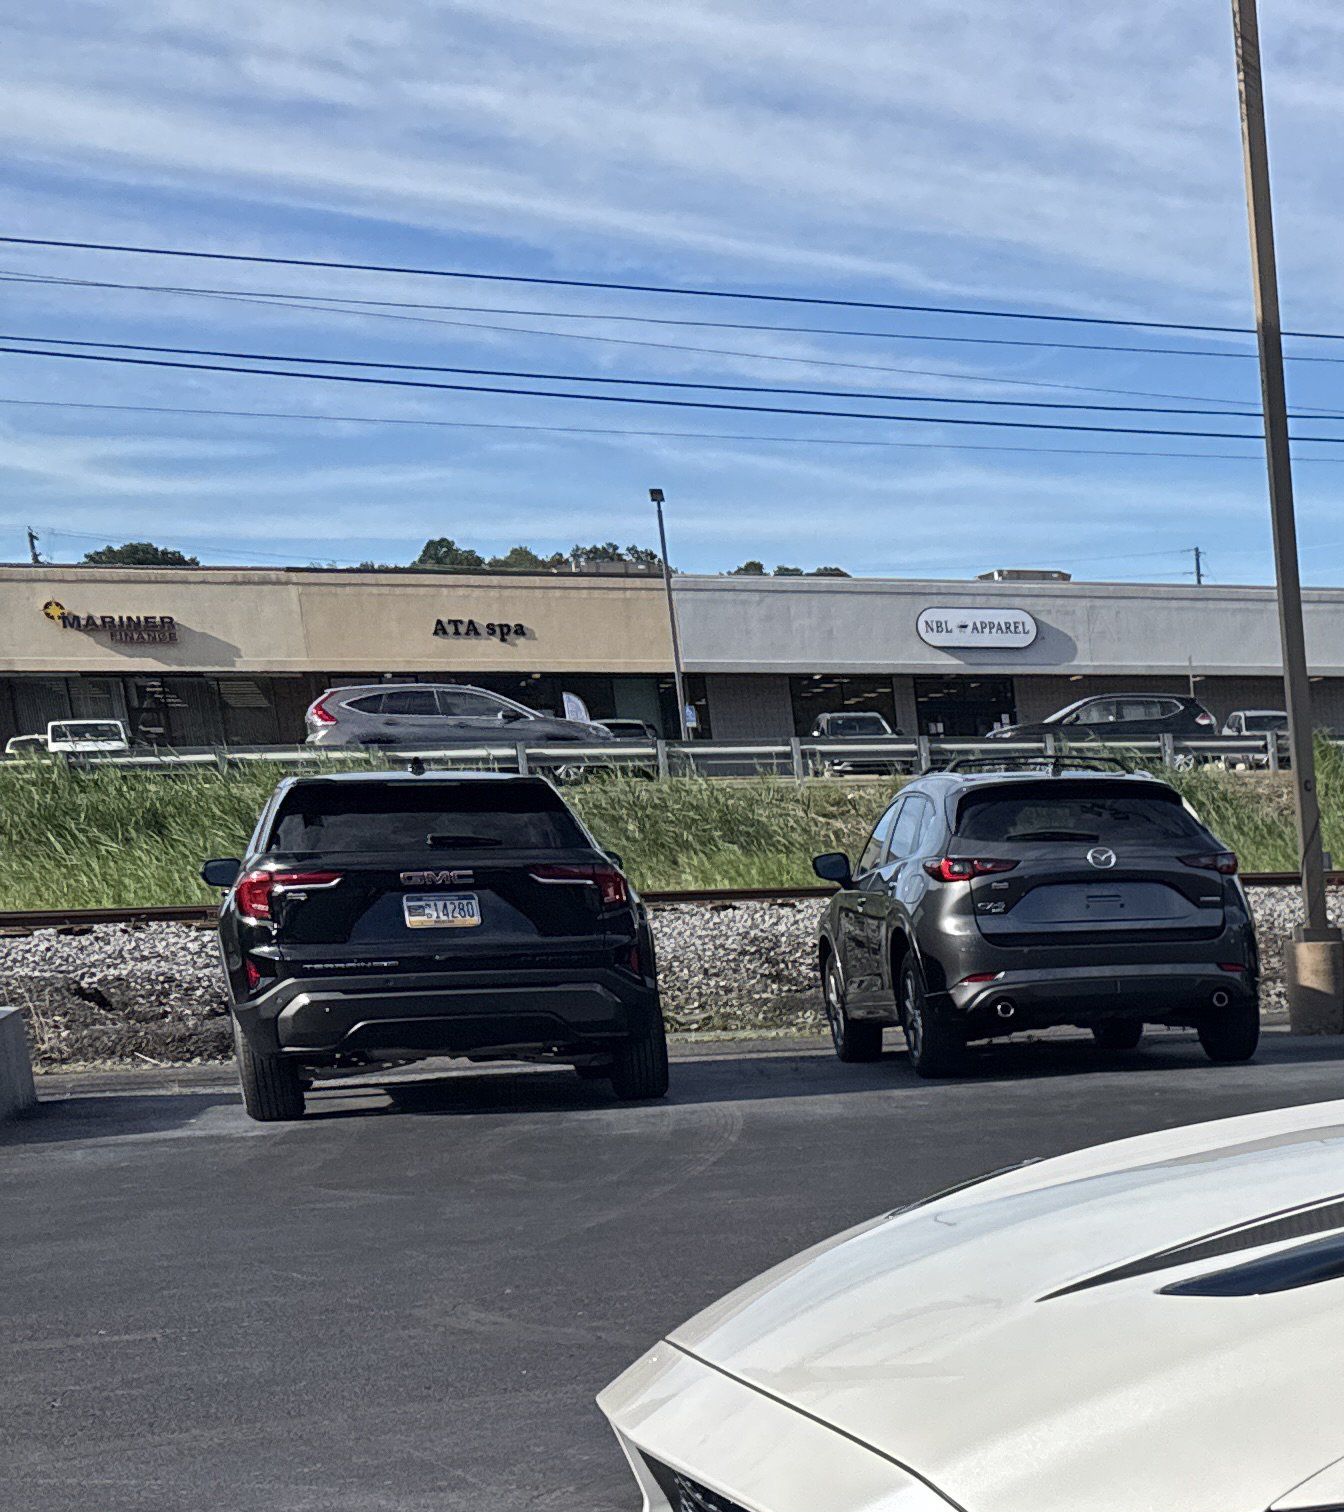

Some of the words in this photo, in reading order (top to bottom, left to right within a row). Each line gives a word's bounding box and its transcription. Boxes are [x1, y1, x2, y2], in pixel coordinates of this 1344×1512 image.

[61, 615, 177, 629] MARINER
[924, 620, 953, 634] NBL
[970, 621, 1030, 635] APPAREL
[110, 631, 178, 643] FINANCE
[433, 619, 481, 636] ATA
[485, 623, 526, 642] spa
[400, 870, 474, 885] GMC
[433, 901, 475, 920] 14280
